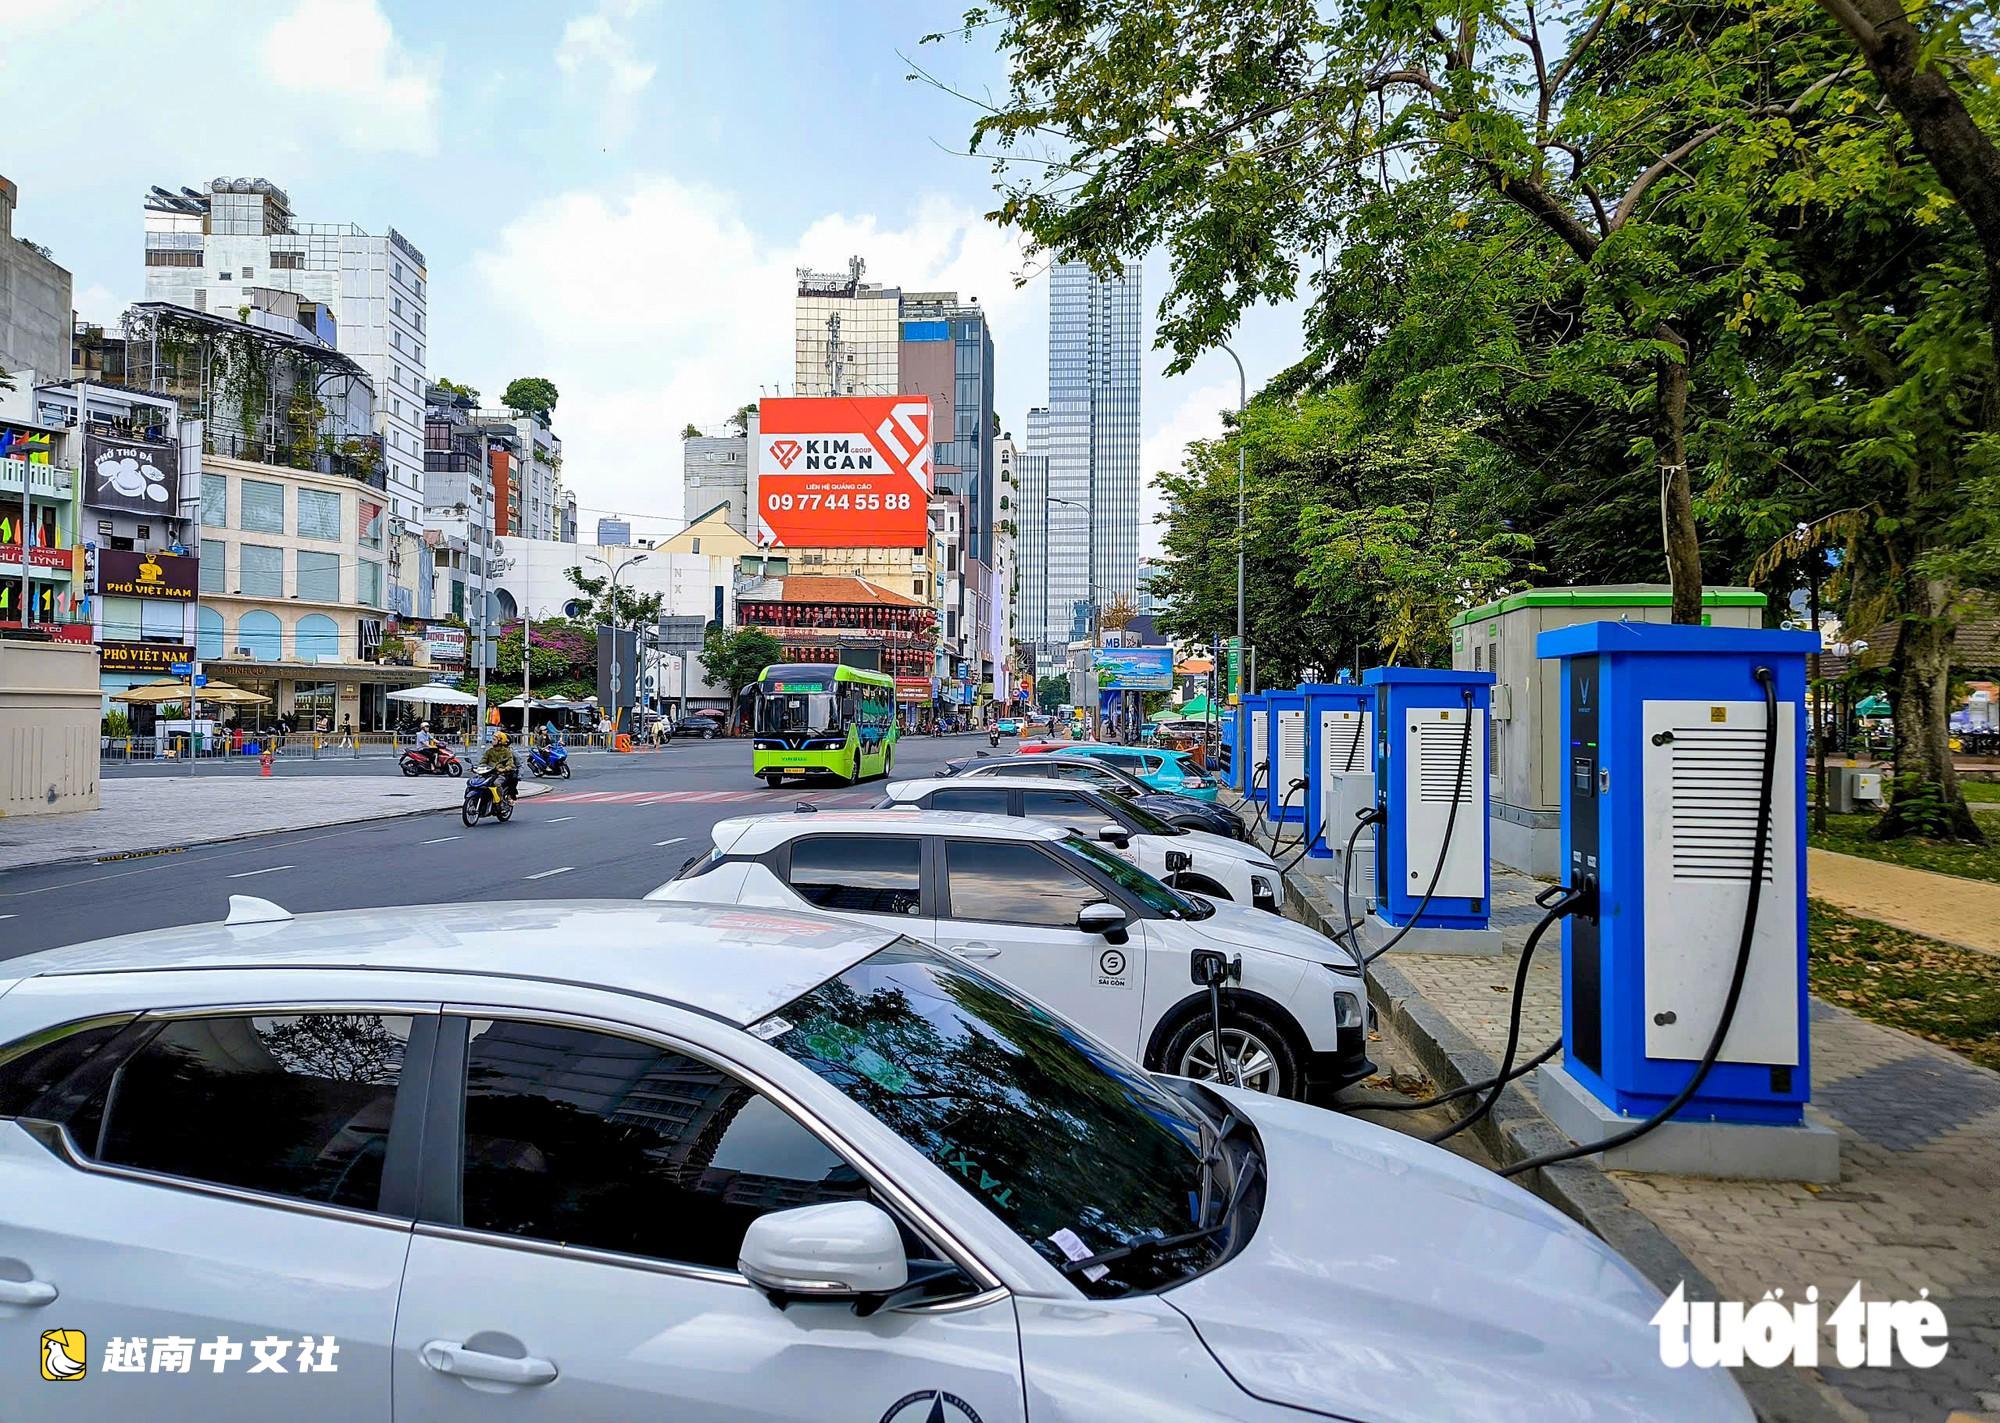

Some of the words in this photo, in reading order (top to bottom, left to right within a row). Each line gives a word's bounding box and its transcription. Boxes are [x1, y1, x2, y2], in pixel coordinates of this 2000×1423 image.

[806, 440, 849, 454] KIM
[806, 455, 872, 470] NGAN
[768, 493, 794, 511] 09
[797, 494, 823, 511] 77
[824, 494, 850, 510] 44
[854, 493, 880, 510] 55
[884, 493, 911, 510] 88
[106, 582, 133, 593] PHỞ
[135, 585, 164, 596] VIỆT
[165, 588, 192, 597] NAM
[1106, 638, 1120, 648] MB
[103, 645, 128, 660] PHỞ
[130, 648, 159, 664] VIỆT
[162, 651, 188, 662] NAM
[937, 1143, 1012, 1209] TAXI
